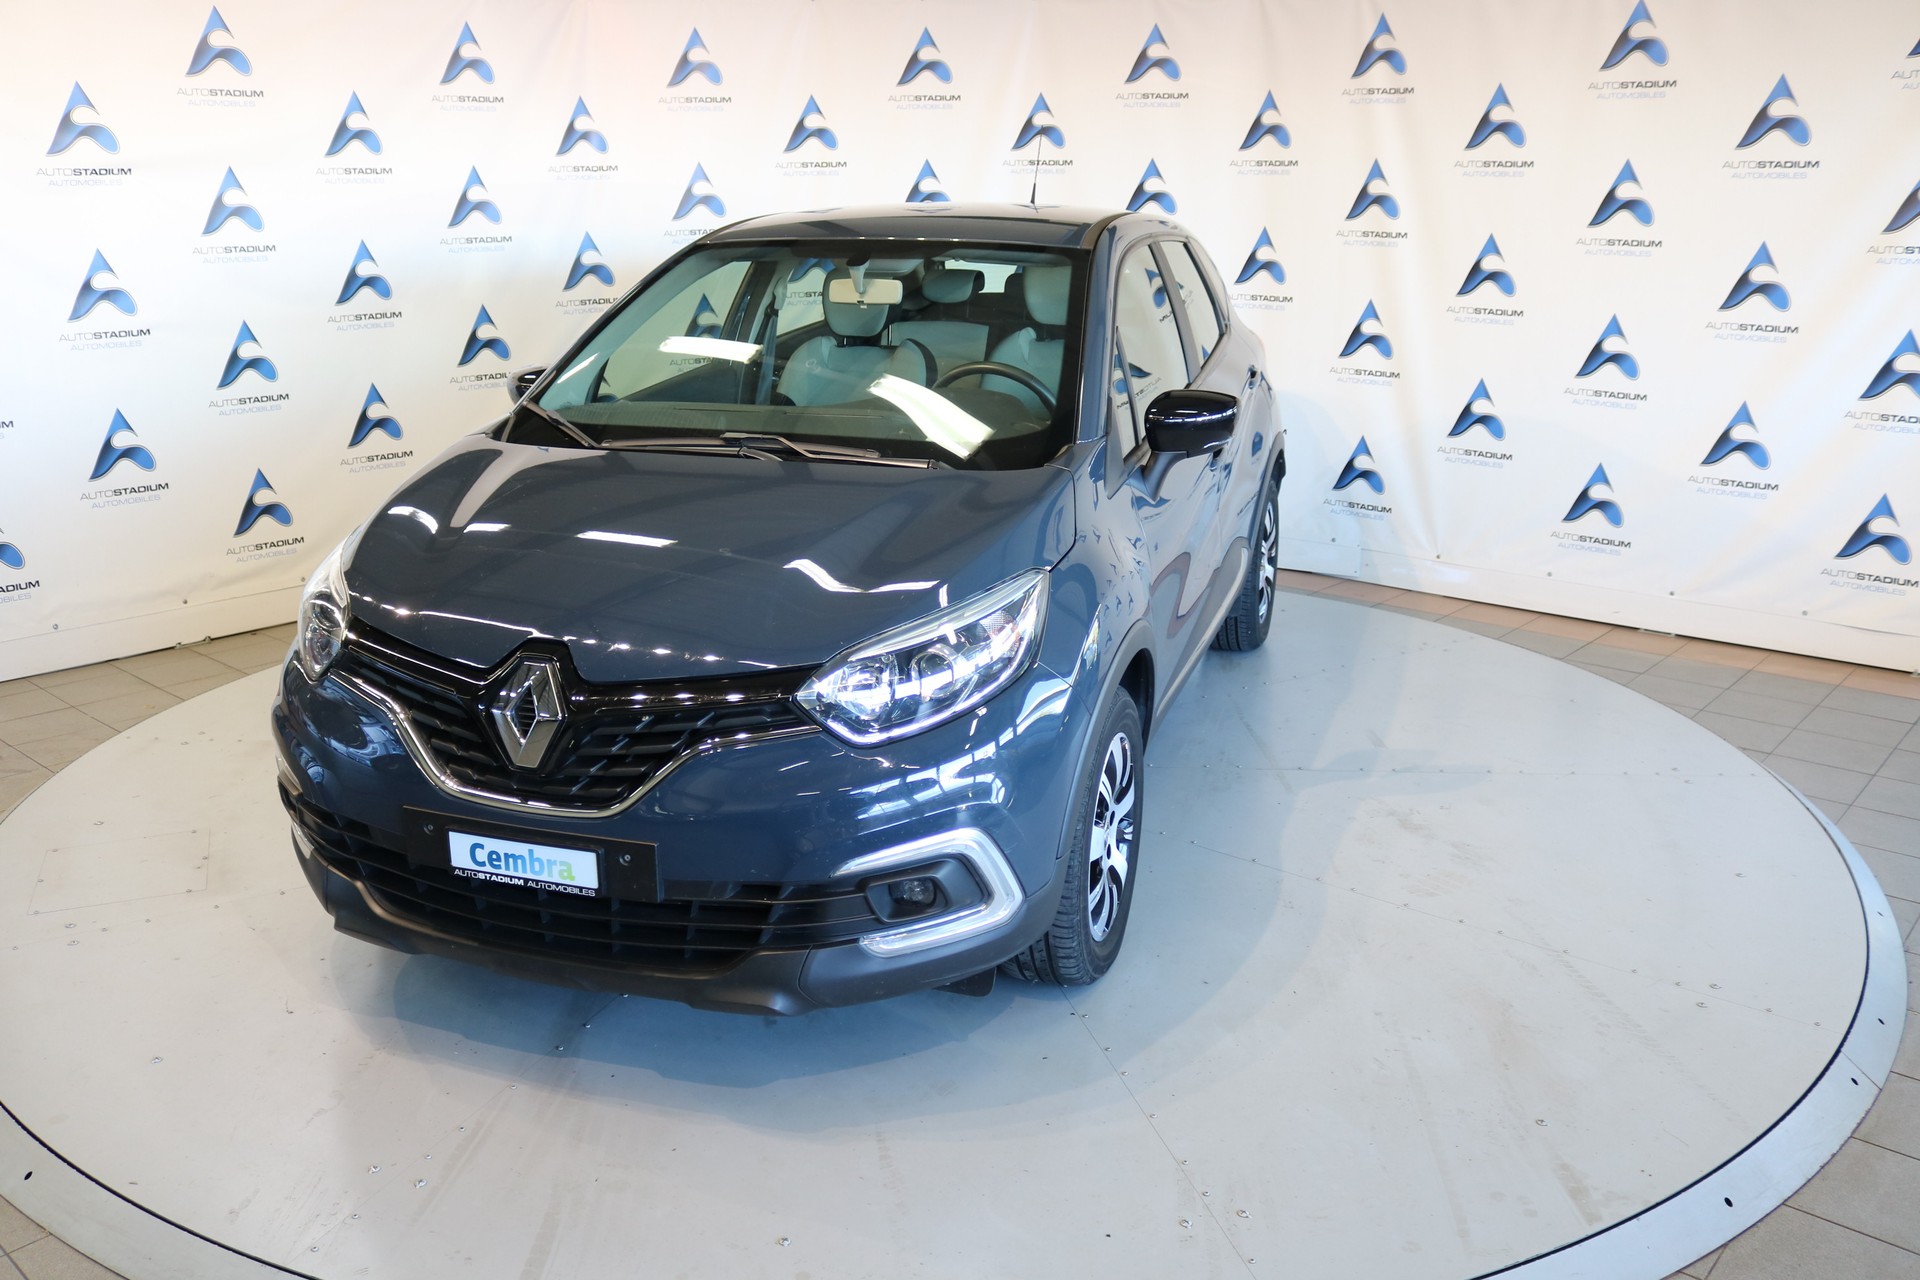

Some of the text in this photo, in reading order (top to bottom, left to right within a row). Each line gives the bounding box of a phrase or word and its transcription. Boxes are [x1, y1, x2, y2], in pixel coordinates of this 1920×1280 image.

[1588, 80, 1677, 90] AUTOSTADIUM
[177, 87, 264, 98] AUTOSTADIUM
[1116, 92, 1189, 100] AUTOSTADIUM
[1342, 87, 1414, 96] AUTOSTADIUM
[432, 94, 504, 104] AUTOSTADIUM
[658, 96, 732, 104] AUTOSTADIUM
[888, 94, 961, 102] AUTOSTADIUM
[1230, 159, 1298, 167] AUTOSTADIUM
[1454, 160, 1534, 168] AUTOSTADIUM
[1722, 160, 1820, 169] AUTOSTADIUM
[36, 167, 132, 177] AUTOSTADIUM
[316, 167, 393, 175] AUTOSTADIUM
[1336, 230, 1407, 239] AUTOSTADIUM
[440, 236, 512, 246] AUTOSTADIUM
[1576, 238, 1662, 248] AUTOSTADIUM
[192, 244, 276, 255] AUTOSTADIUM
[327, 311, 402, 323] AUTOSTADIUM
[1447, 306, 1523, 317] AUTOSTADIUM
[1706, 321, 1799, 334] AUTOSTADIUM
[59, 328, 151, 342] AUTOSTADIUM
[1330, 366, 1400, 379] AUTOSTADIUM
[1564, 387, 1647, 401] AUTOSTADIUM
[208, 393, 290, 408] AUTOSTADIUM
[340, 450, 413, 466] AUTOSTADIUM
[1438, 445, 1513, 462] AUTOSTADIUM
[1688, 475, 1779, 491] AUTOSTADIUM
[80, 482, 169, 501] AUTOSTADIUM
[1323, 497, 1392, 514] AUTOSTADIUM
[1551, 530, 1631, 549] AUTOSTADIUM
[226, 536, 305, 556] AUTOSTADIUM
[1821, 567, 1919, 588] AUTOSTADIUM
[469, 842, 576, 882] Cembra
[454, 868, 596, 897] AUTOSTADIUM AUTOMOBILES
